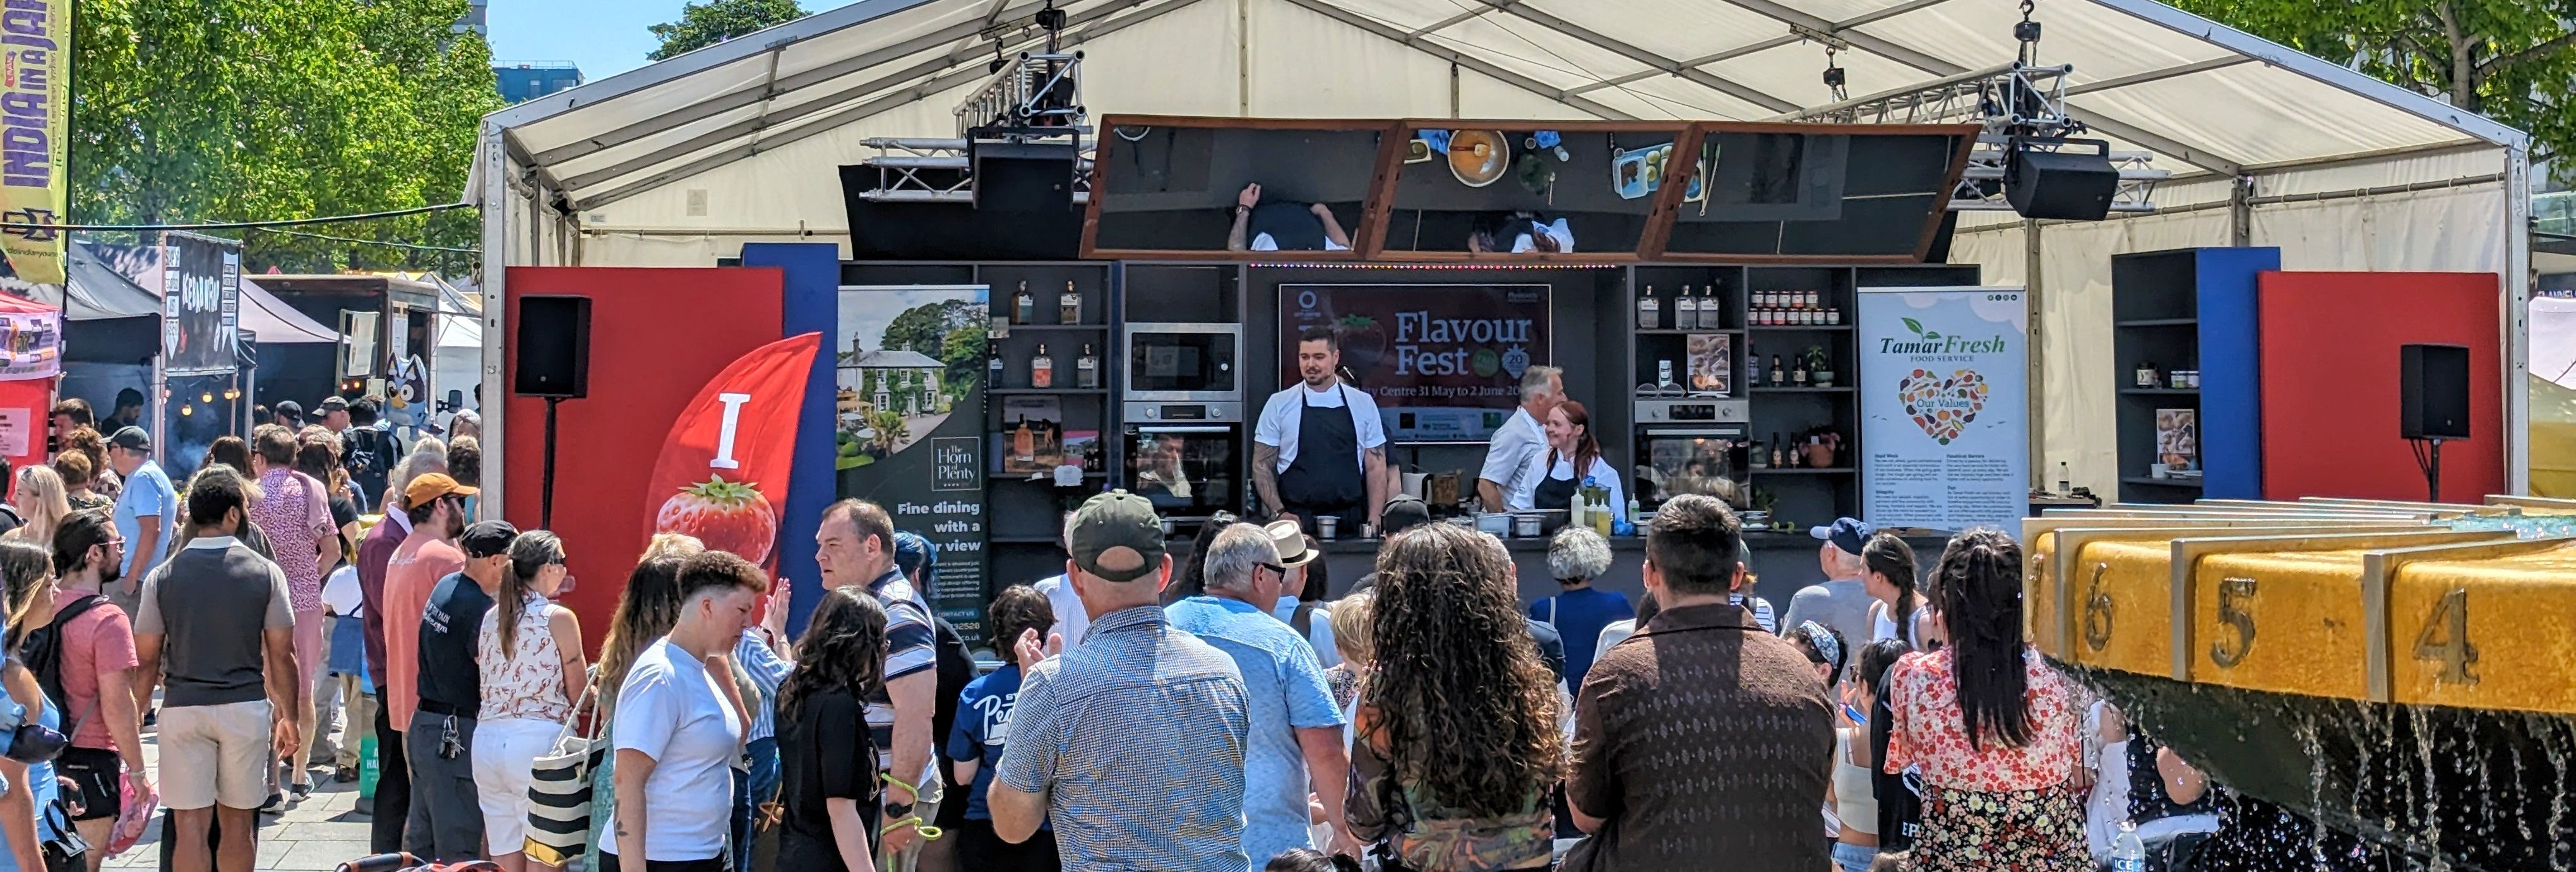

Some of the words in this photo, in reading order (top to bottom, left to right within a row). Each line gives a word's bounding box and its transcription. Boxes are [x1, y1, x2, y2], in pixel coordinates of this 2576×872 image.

[20, 49, 47, 65] A
[20, 68, 47, 90] IN
[1, 92, 49, 188] INDIA
[1395, 311, 1532, 343] Flavour
[1395, 345, 1469, 375] Fest
[1380, 386, 1416, 397] Centre
[1419, 386, 1429, 396] 31
[1432, 386, 1455, 398] May
[1457, 386, 1469, 396] to
[1470, 387, 1477, 396] 2
[1479, 386, 1505, 396] June
[1508, 386, 1520, 396] 20
[1916, 398, 1935, 408] Our
[1938, 398, 1970, 408] Values
[710, 393, 751, 469] I
[938, 448, 972, 464] Horn
[938, 465, 975, 483] Plenty
[898, 501, 929, 515] Fine
[933, 500, 980, 515] dining
[934, 520, 968, 533] with
[972, 523, 981, 532] a
[945, 539, 981, 552] view
[2084, 563, 2113, 652] 6
[2211, 576, 2257, 669] 5
[2412, 587, 2480, 685] 4
[1902, 821, 1920, 837] EP
[2114, 859, 2133, 870] ICE
